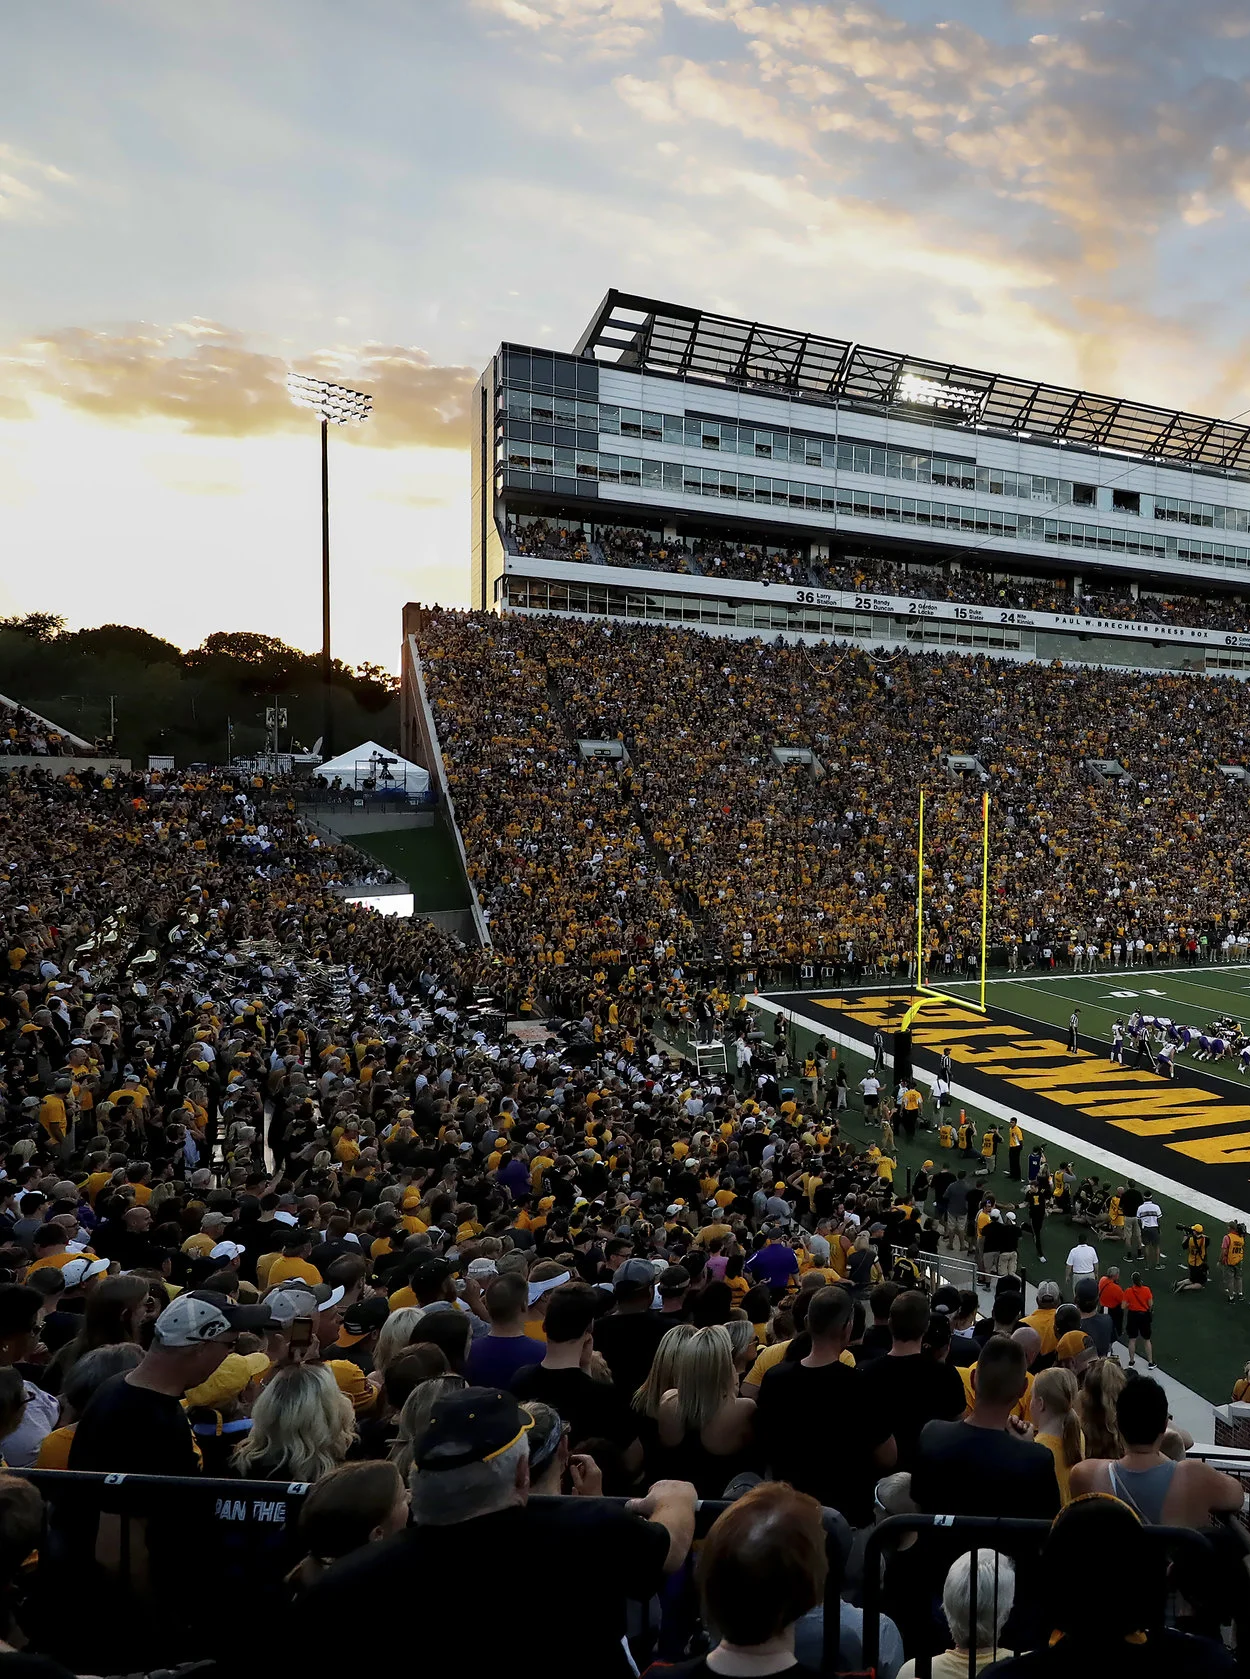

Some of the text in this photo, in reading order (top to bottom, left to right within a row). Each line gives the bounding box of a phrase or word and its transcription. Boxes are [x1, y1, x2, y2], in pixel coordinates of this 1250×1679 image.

[796, 591, 814, 603] 36
[855, 598, 871, 609] 25
[909, 603, 916, 613] 2
[954, 607, 967, 619] 15
[1000, 612, 1015, 623] 24
[1055, 616, 1081, 625] PAUL
[1097, 621, 1149, 632] BRECHLER
[1154, 627, 1184, 636] PRESS
[1190, 630, 1208, 638] BOX
[1225, 635, 1237, 646] 62
[292, 1484, 302, 1493] 4
[252, 1500, 287, 1522] THE
